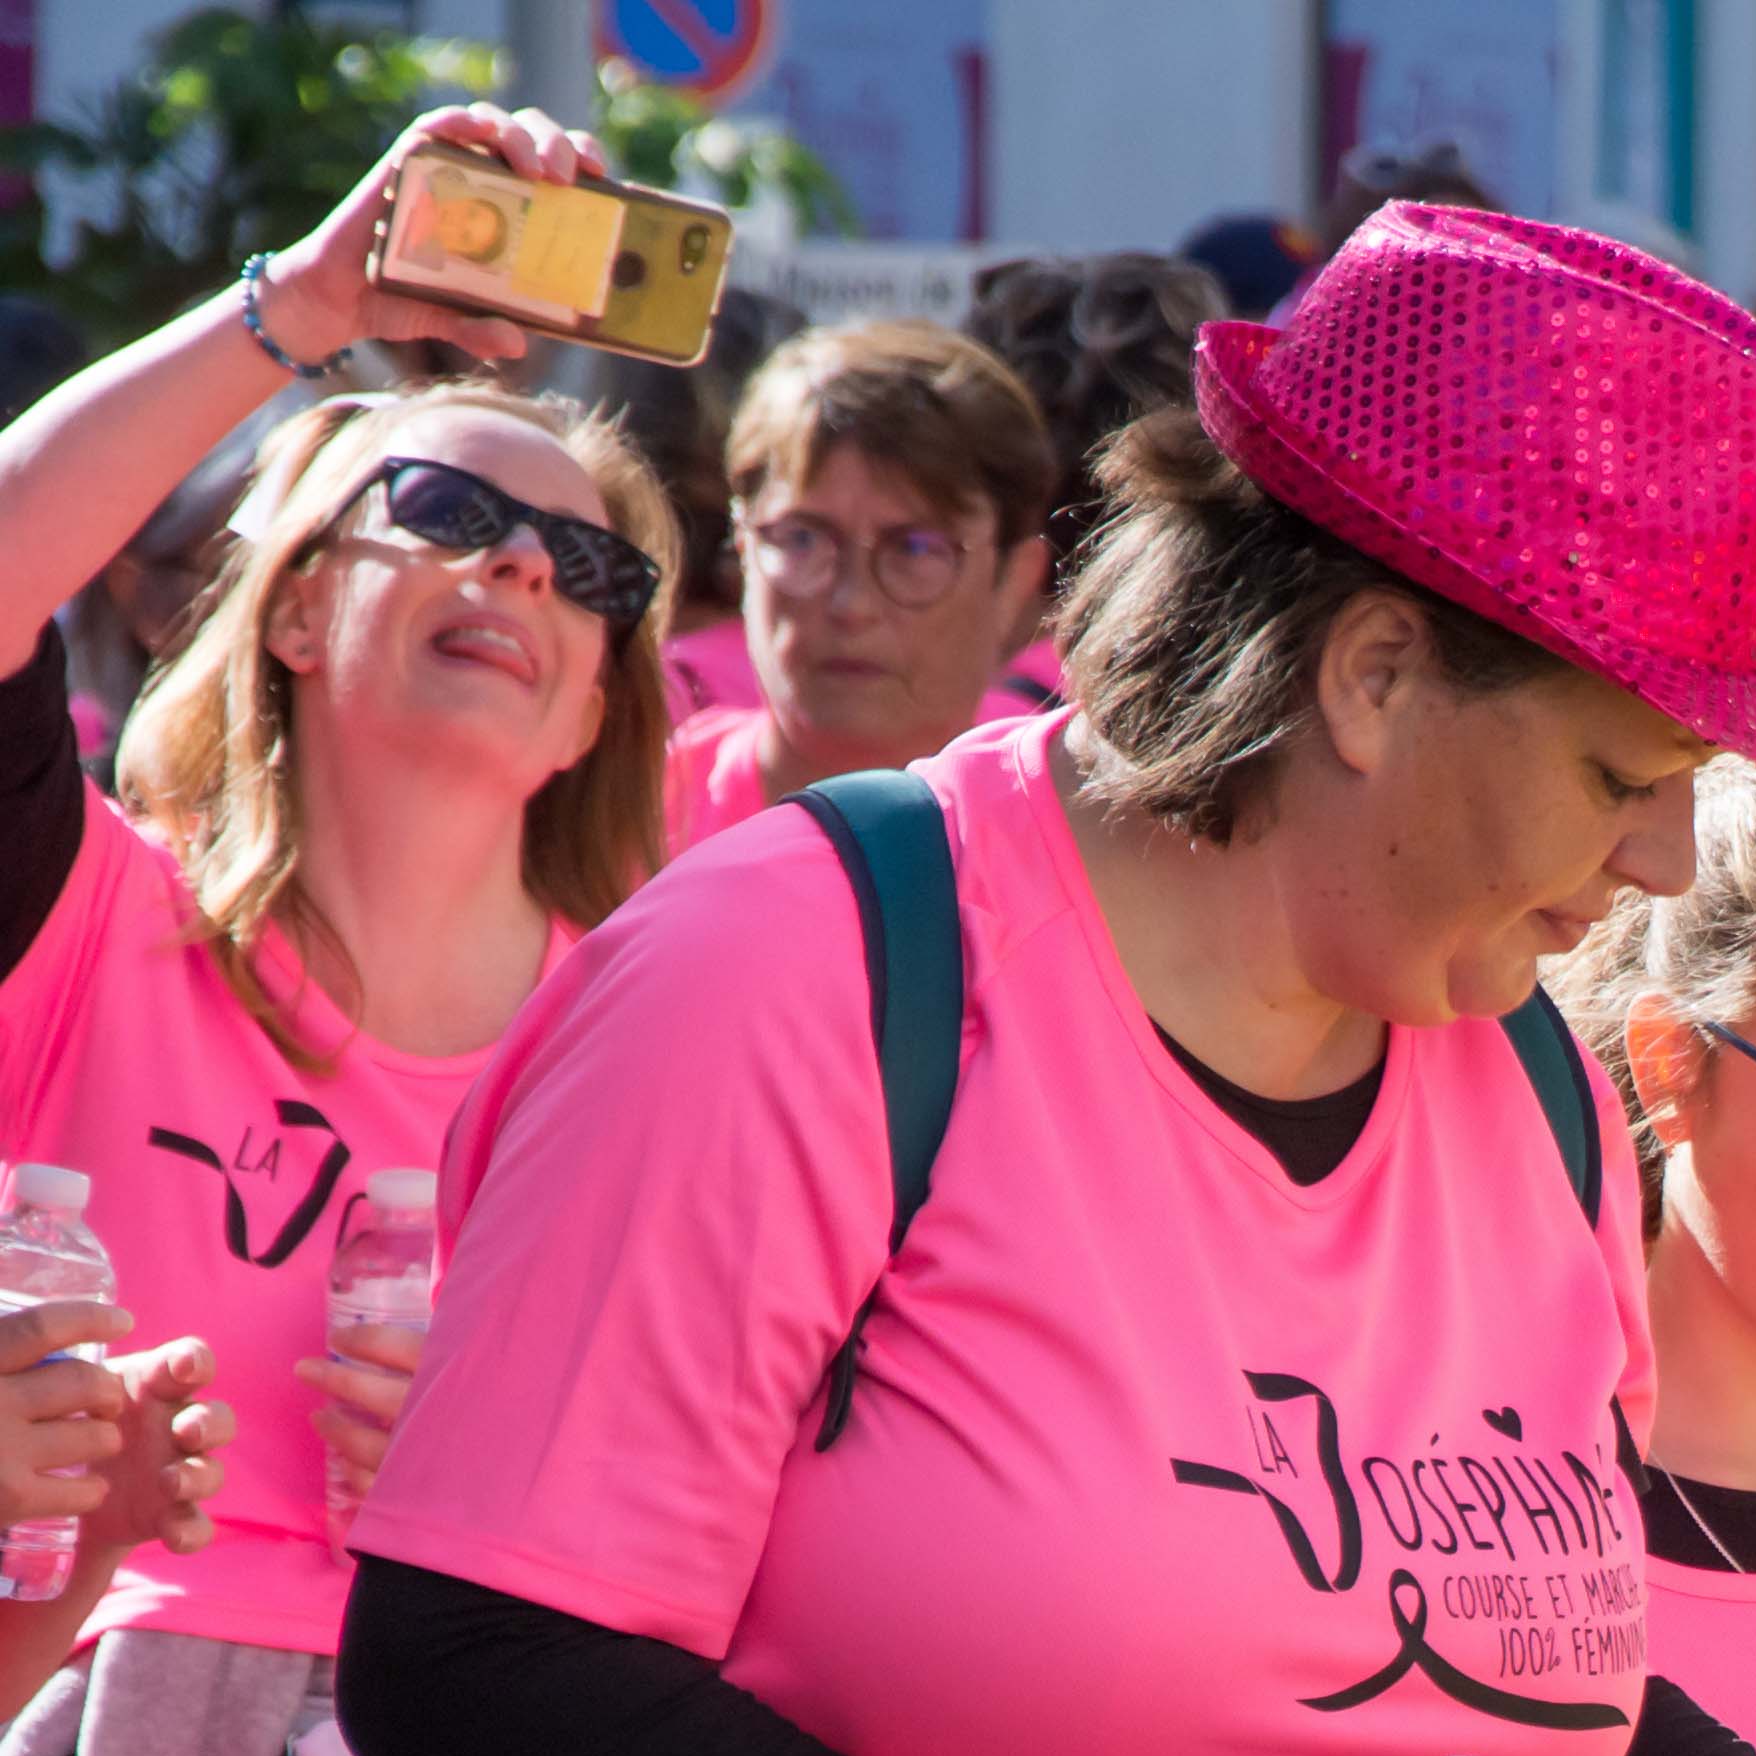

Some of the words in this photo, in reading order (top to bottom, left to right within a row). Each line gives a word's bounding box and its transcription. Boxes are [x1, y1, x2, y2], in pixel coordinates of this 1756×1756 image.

[234, 1125, 283, 1183] LA
[1246, 1404, 1299, 1479] LA
[1443, 1575, 1538, 1621] COURSE
[1545, 1574, 1574, 1618] ET
[1499, 1626, 1561, 1678] 100%
